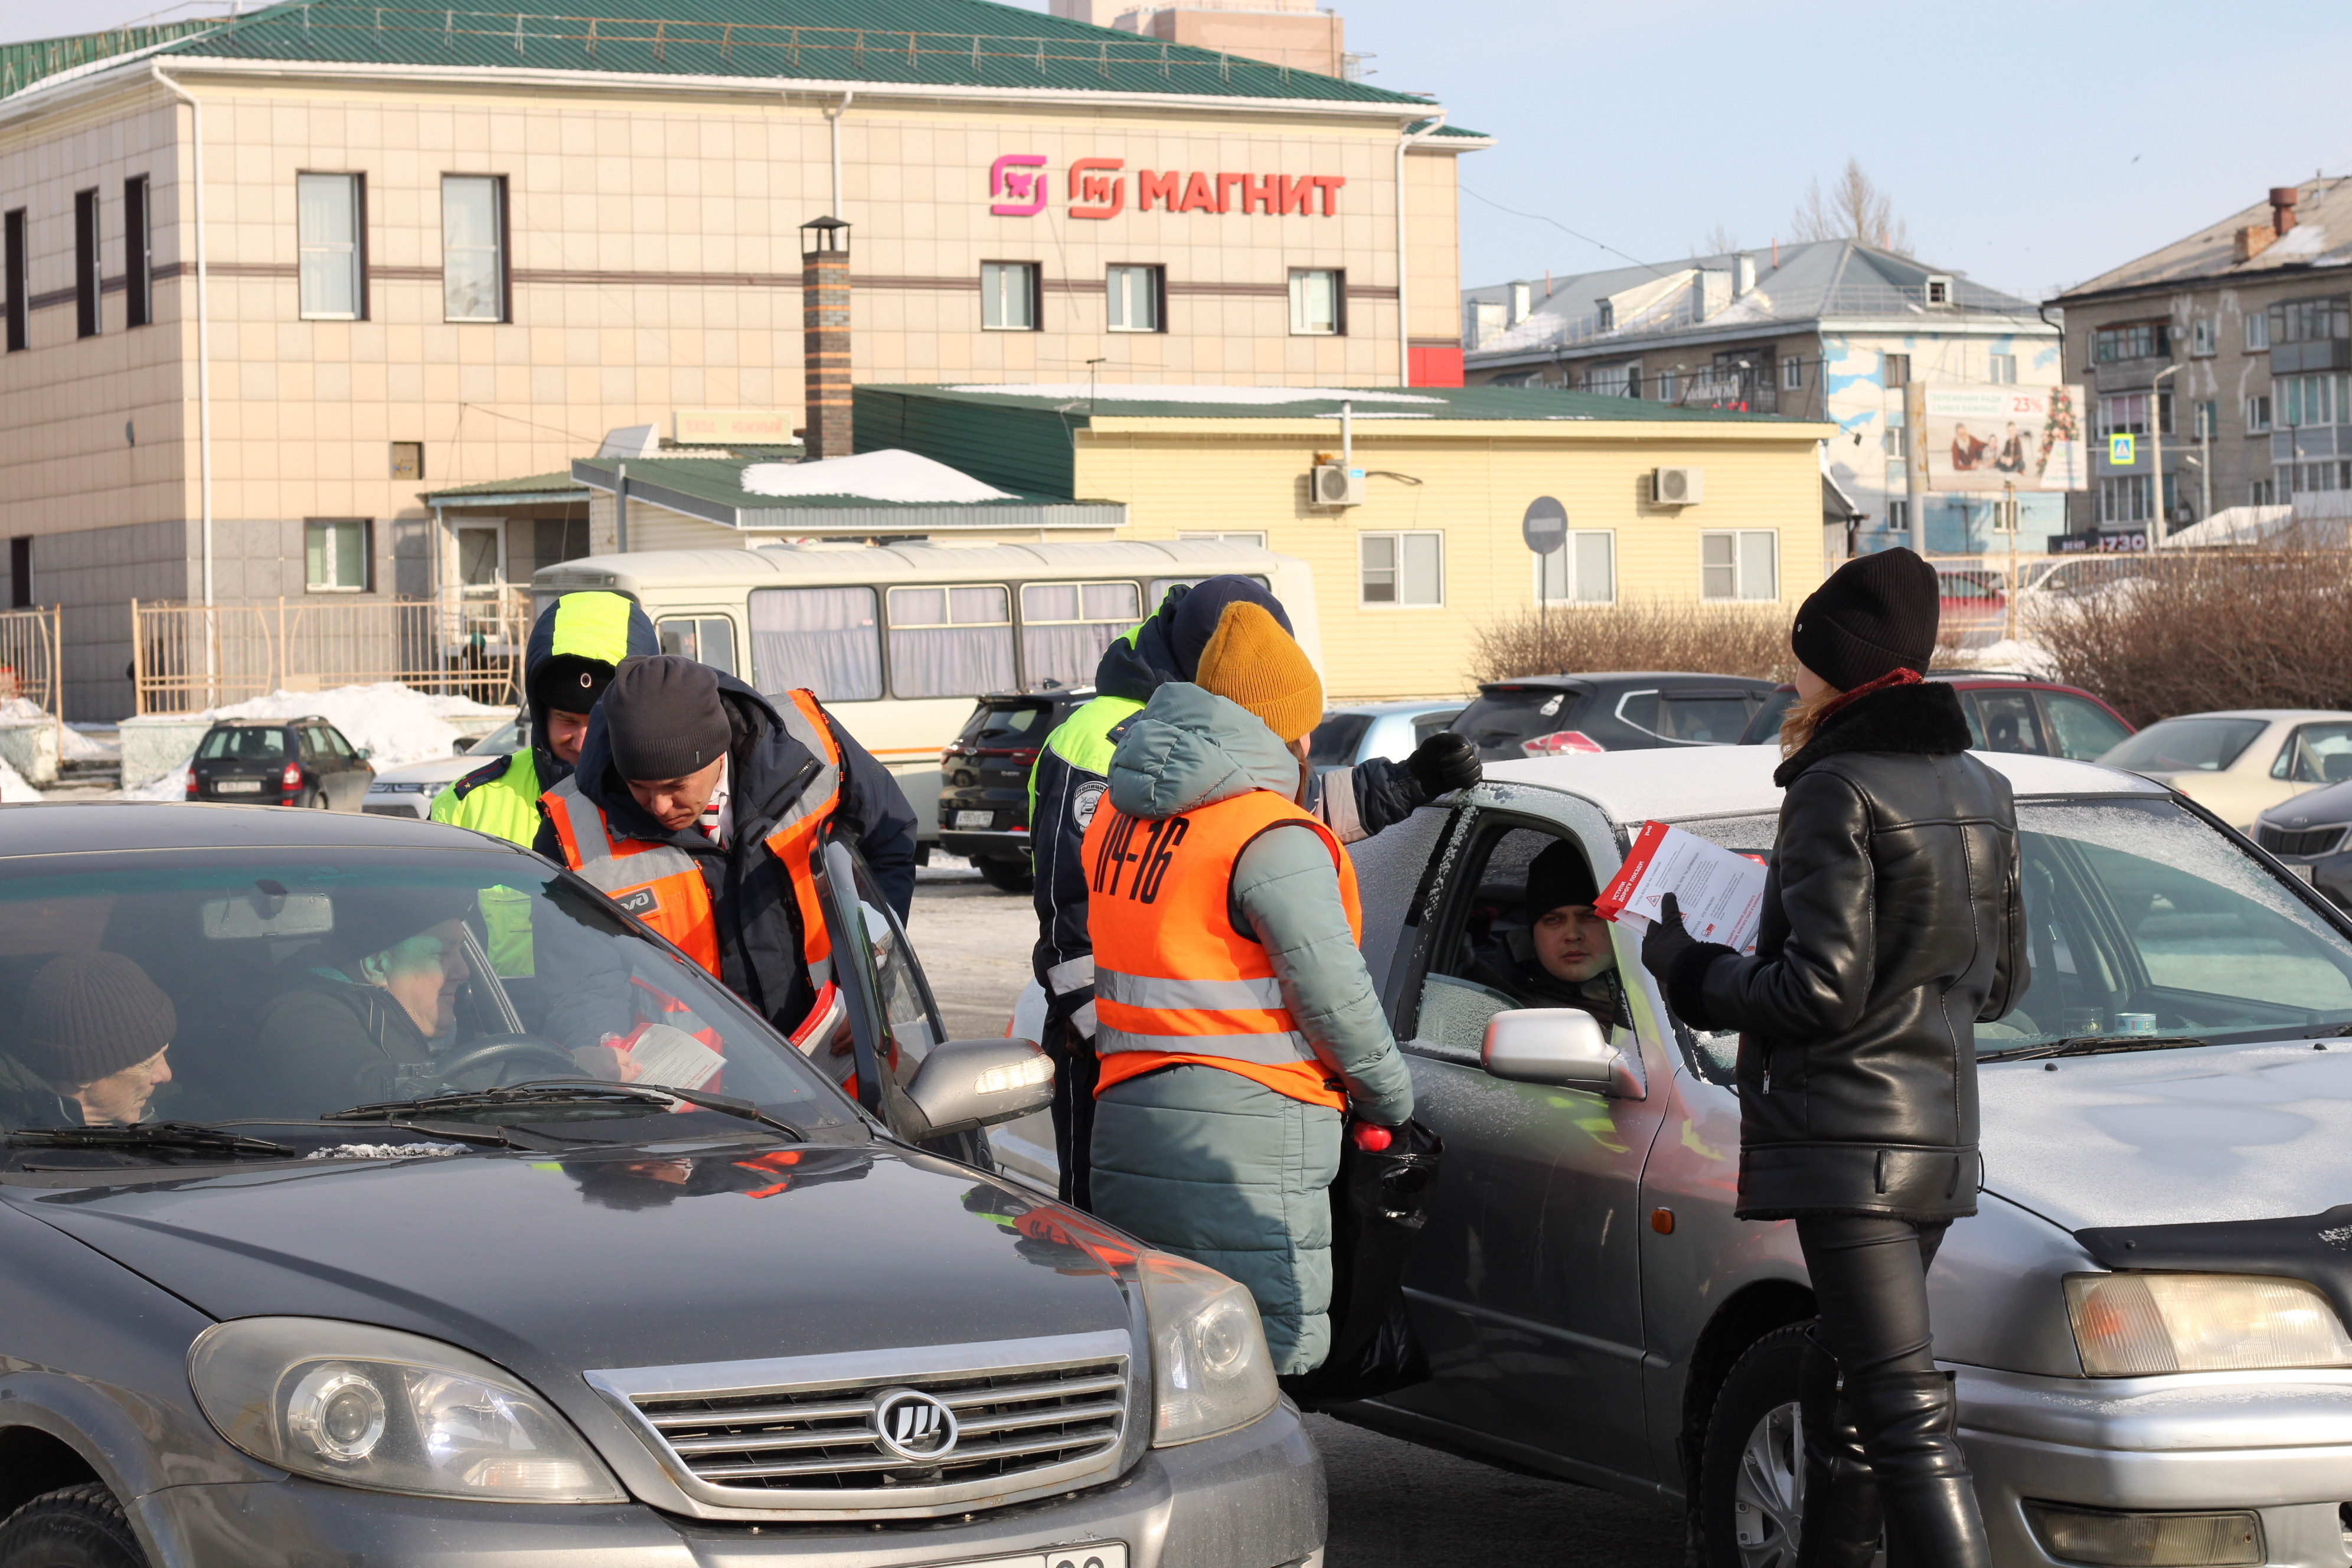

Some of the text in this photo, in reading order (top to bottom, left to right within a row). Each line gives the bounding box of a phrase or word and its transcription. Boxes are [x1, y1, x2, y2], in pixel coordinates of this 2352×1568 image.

[1139, 169, 1346, 217] МАГНИТ
[2013, 396, 2044, 413] 23%
[1076, 784, 1106, 795] ПОЛИЦИ
[1093, 811, 1190, 905] ПЧ-16
[1612, 880, 1626, 901] УСТУПИ
[1618, 860, 1644, 902] ДОРОГУ ПОЕЗДУ!
